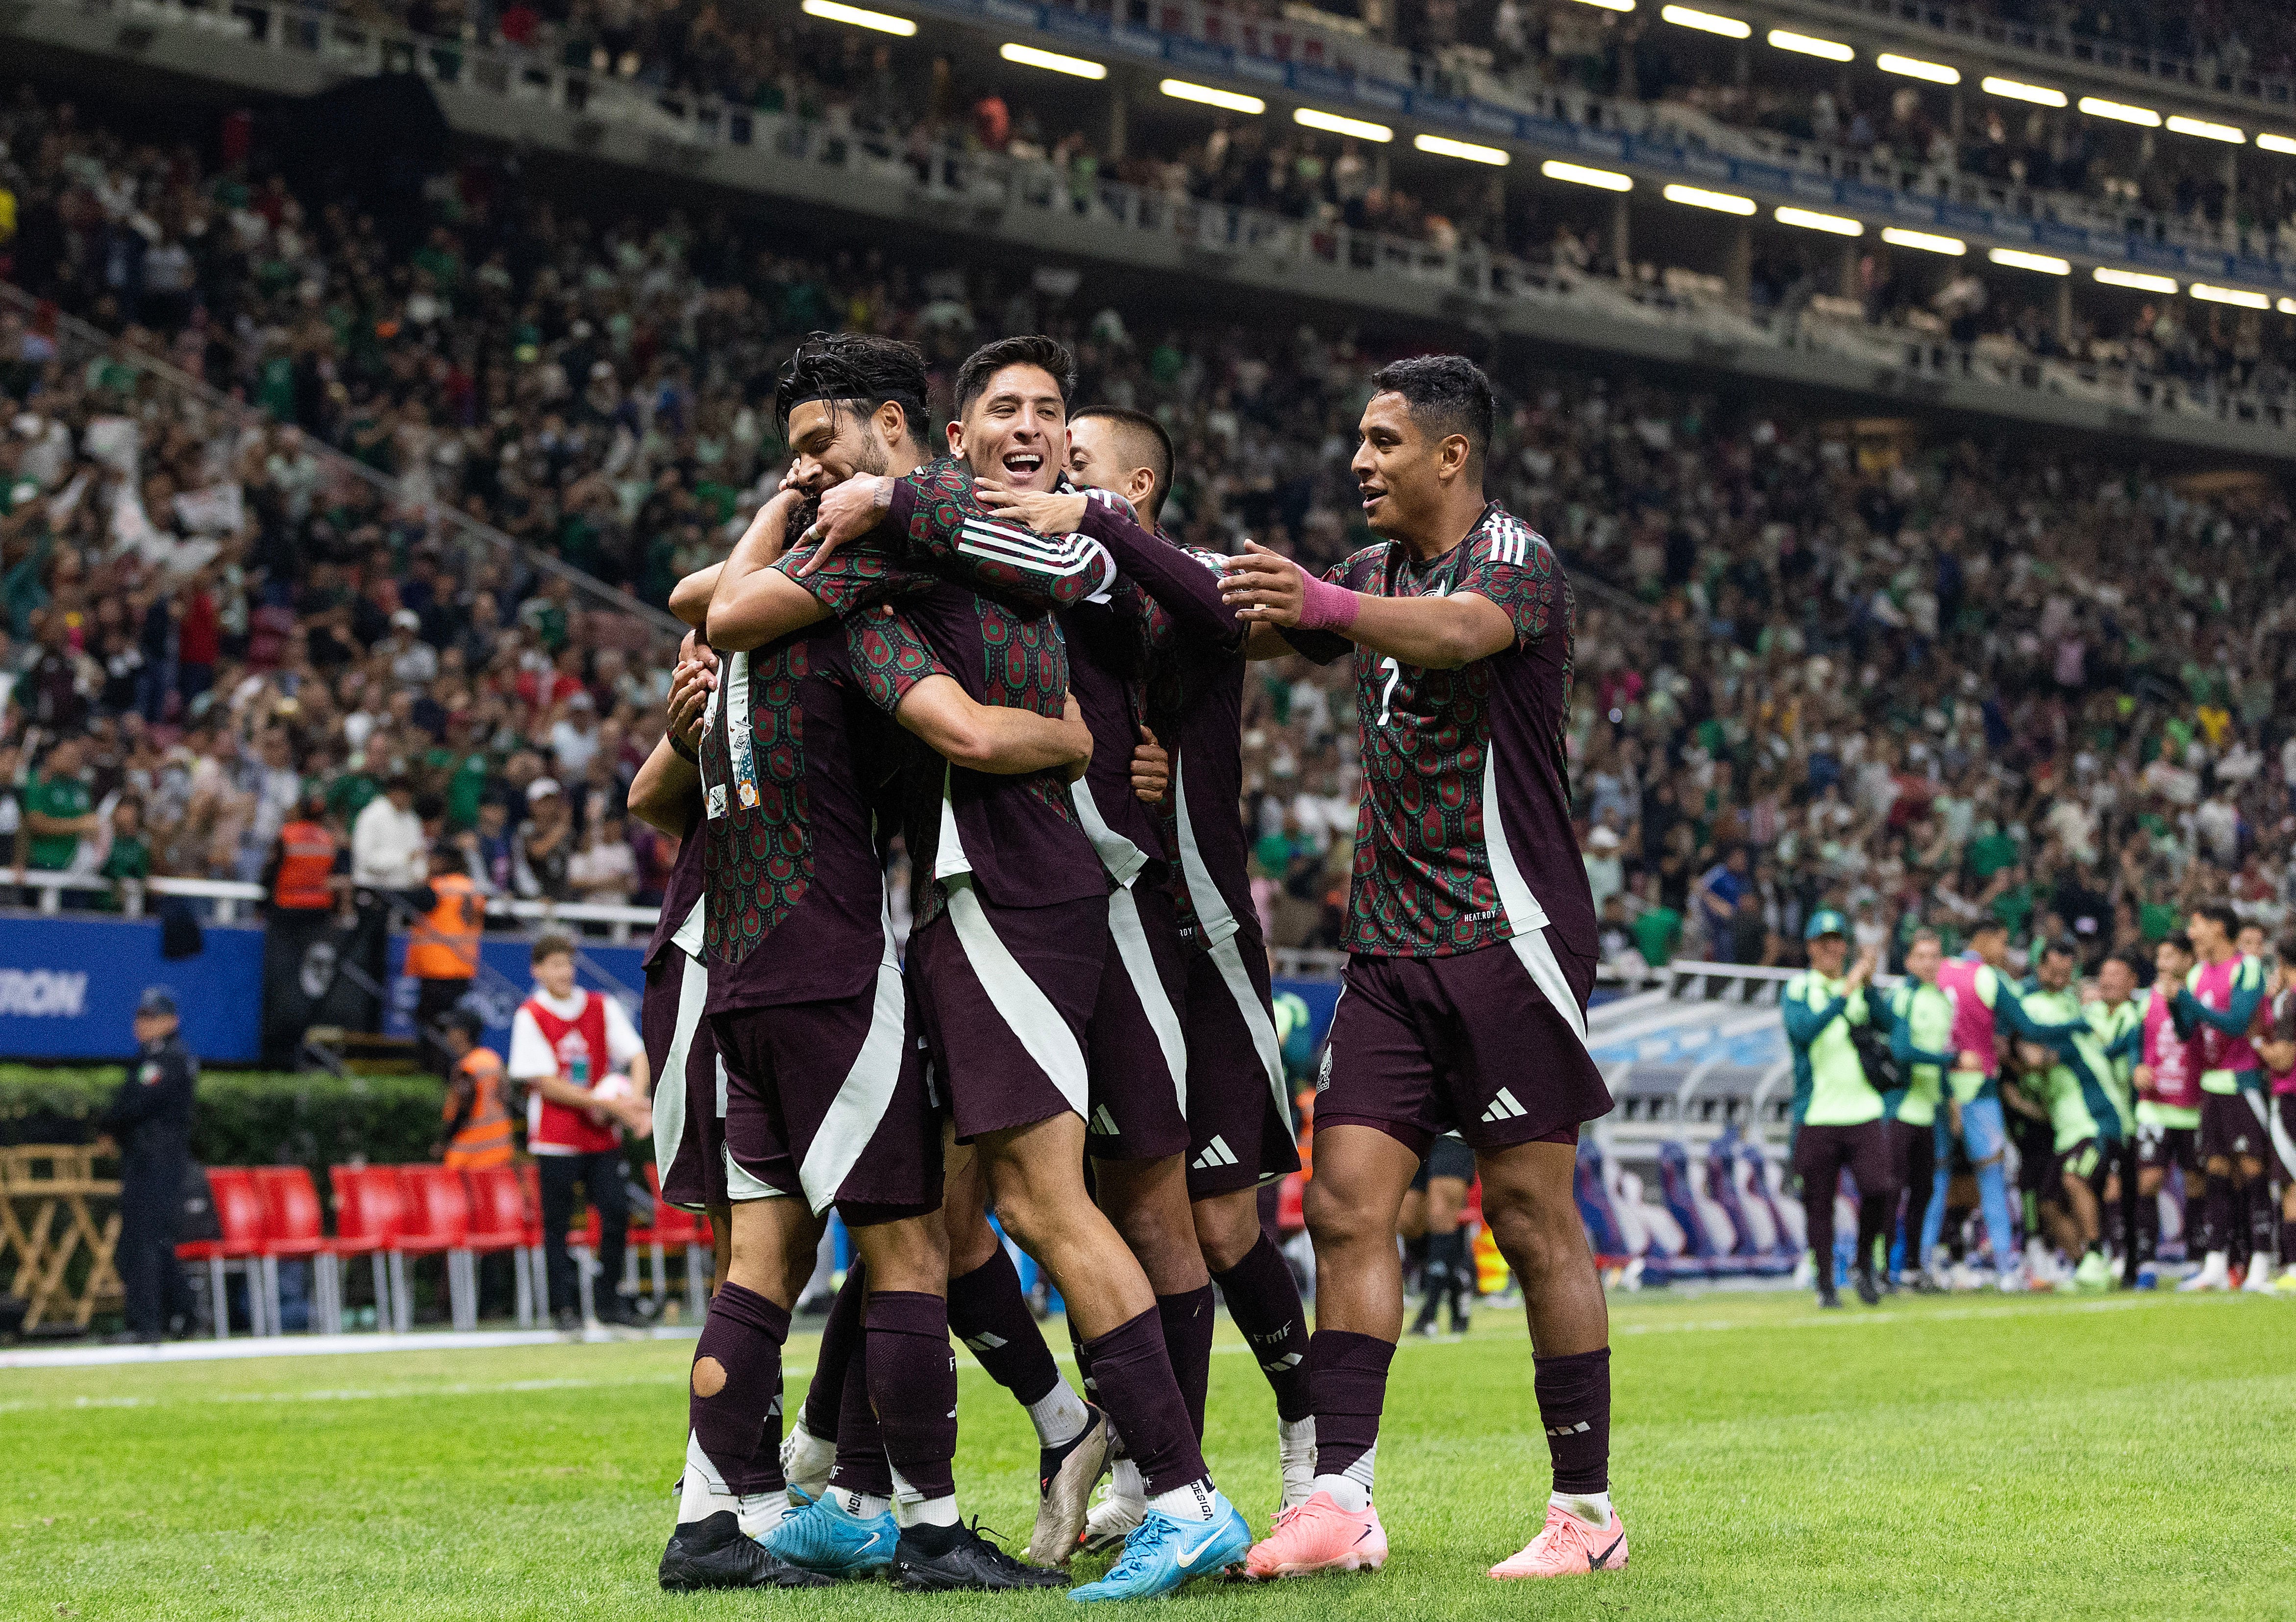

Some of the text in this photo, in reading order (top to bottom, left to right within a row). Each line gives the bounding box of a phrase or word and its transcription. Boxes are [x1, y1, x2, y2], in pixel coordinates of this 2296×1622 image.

[1377, 657, 1399, 725] 7
[1464, 910, 1496, 922] HEAT.RDY
[1190, 1481, 1213, 1521] DESIGN
